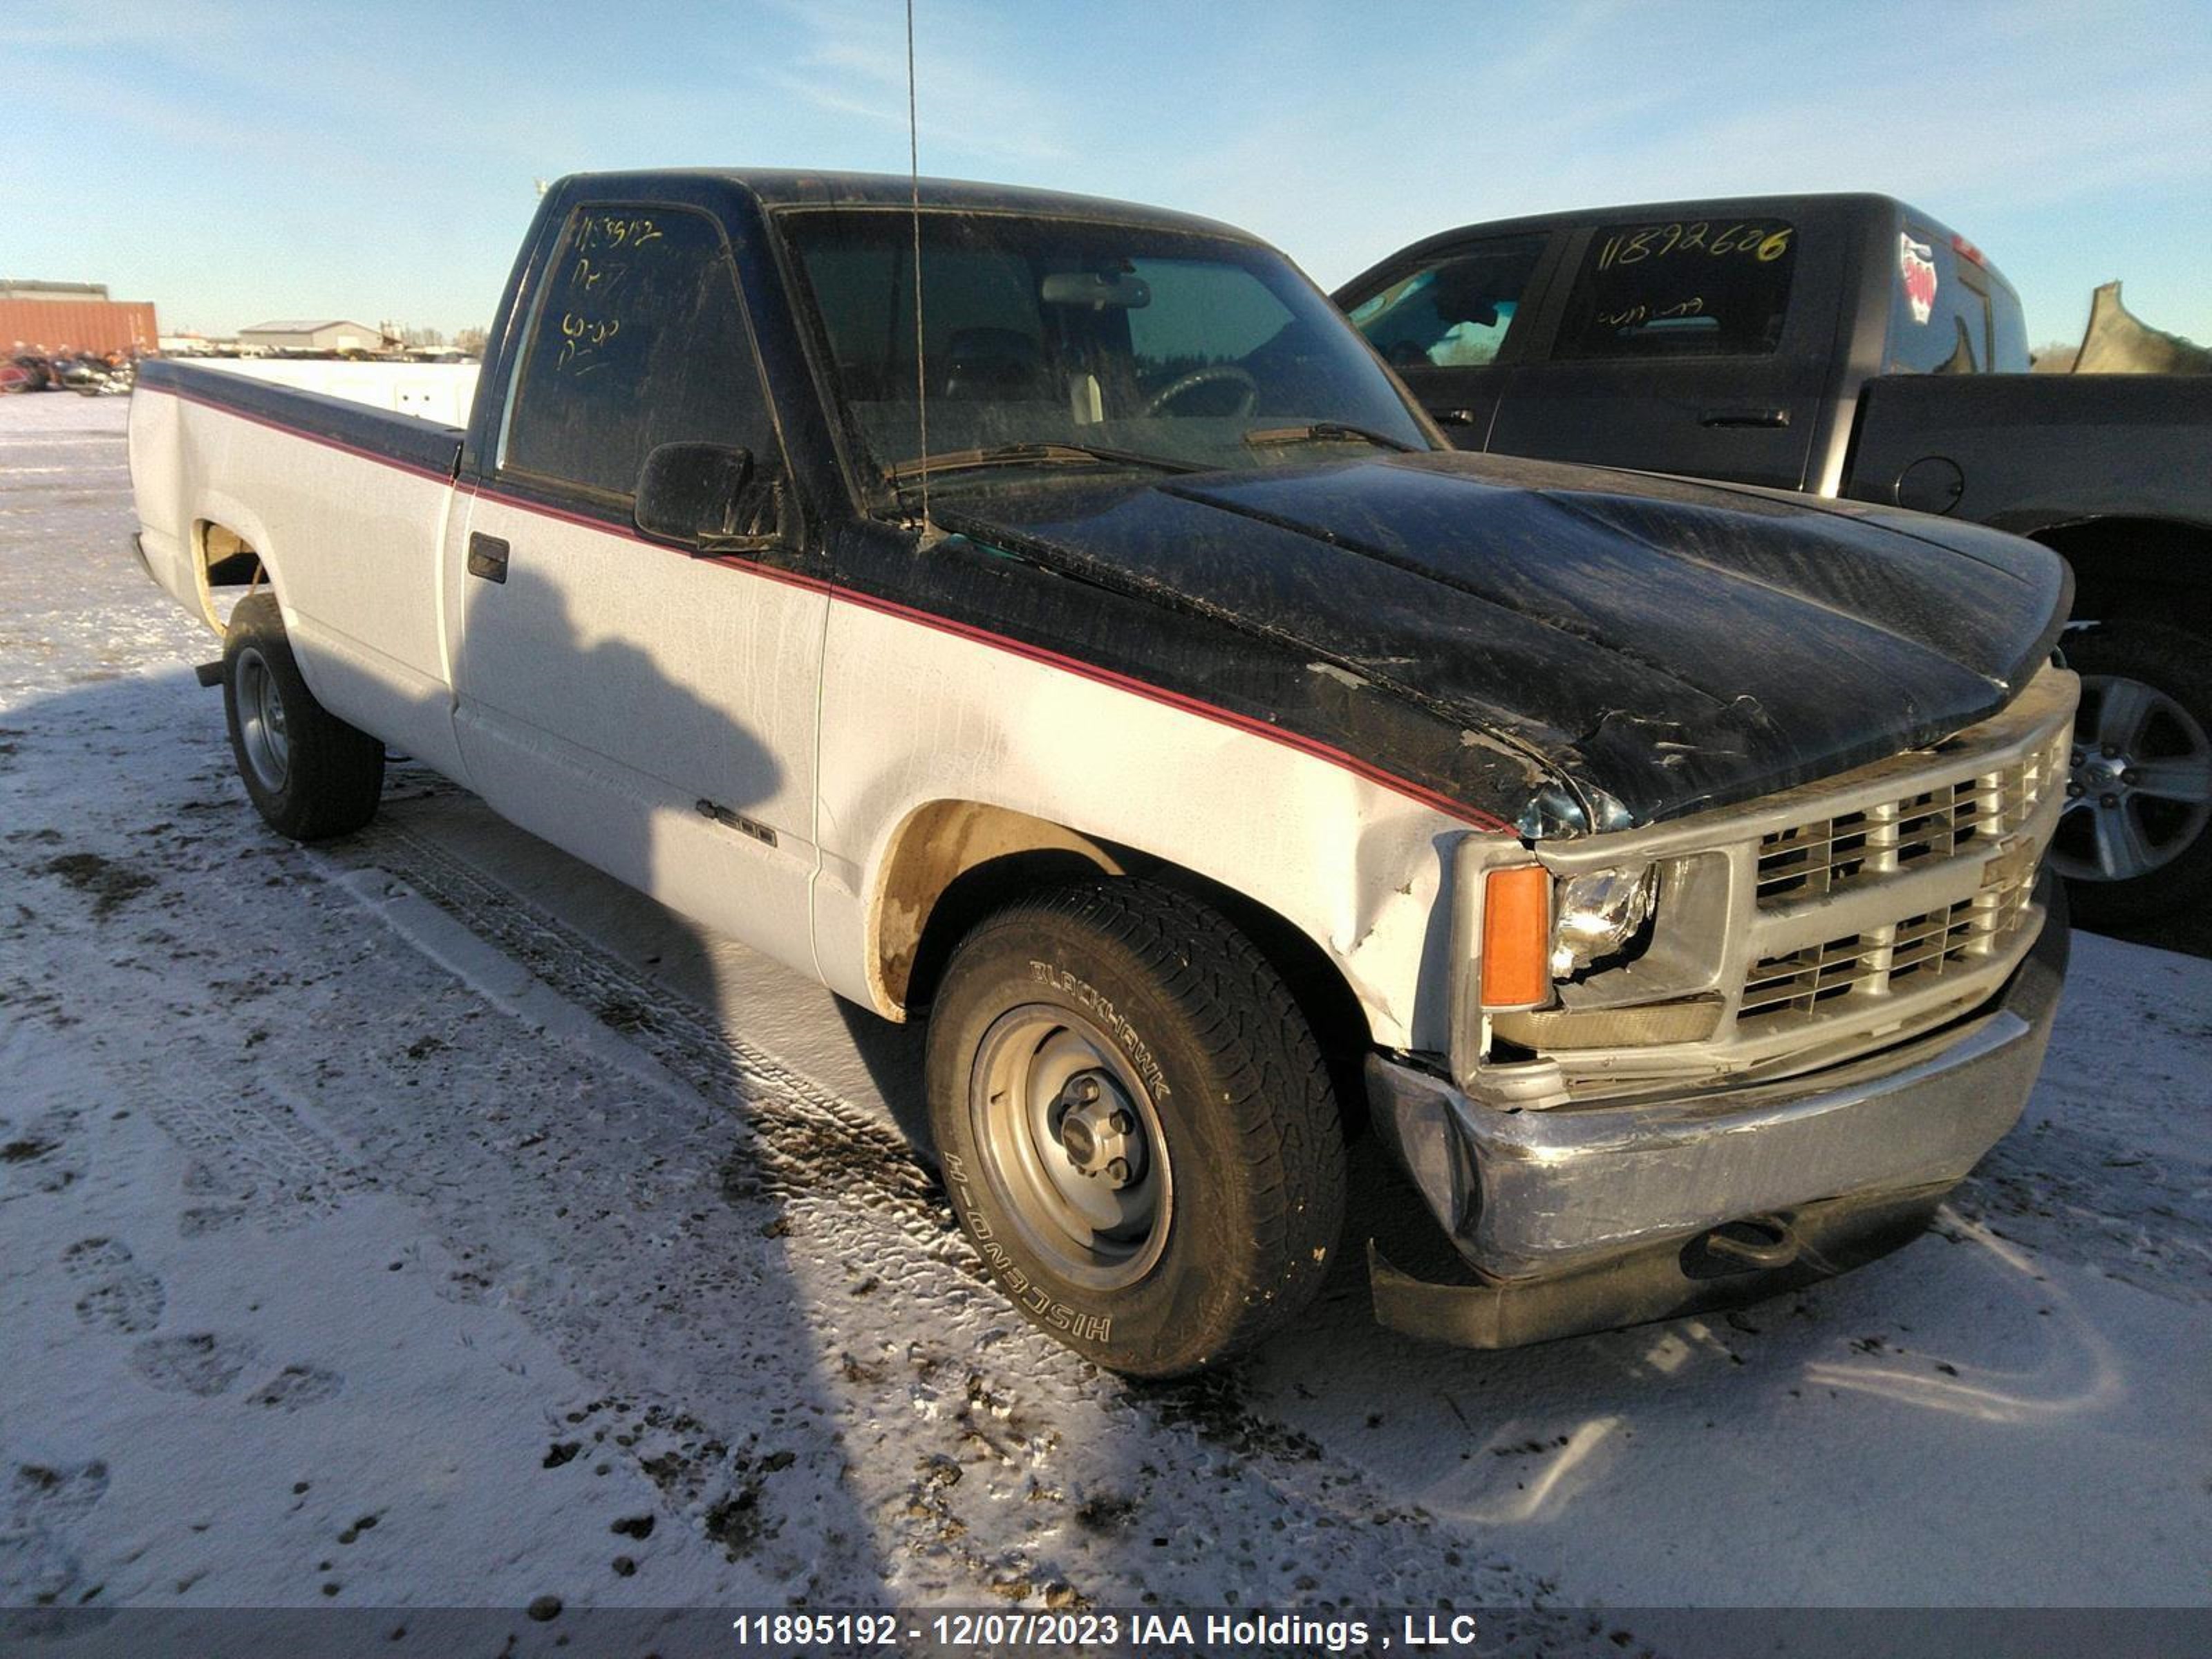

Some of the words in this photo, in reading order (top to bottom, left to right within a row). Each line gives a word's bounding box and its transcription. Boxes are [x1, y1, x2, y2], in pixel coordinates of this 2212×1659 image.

[1597, 221, 1793, 271] 11892606
[1029, 959, 1172, 1101] BLACKHAWK
[943, 1151, 1112, 1343] HISCEND-H
